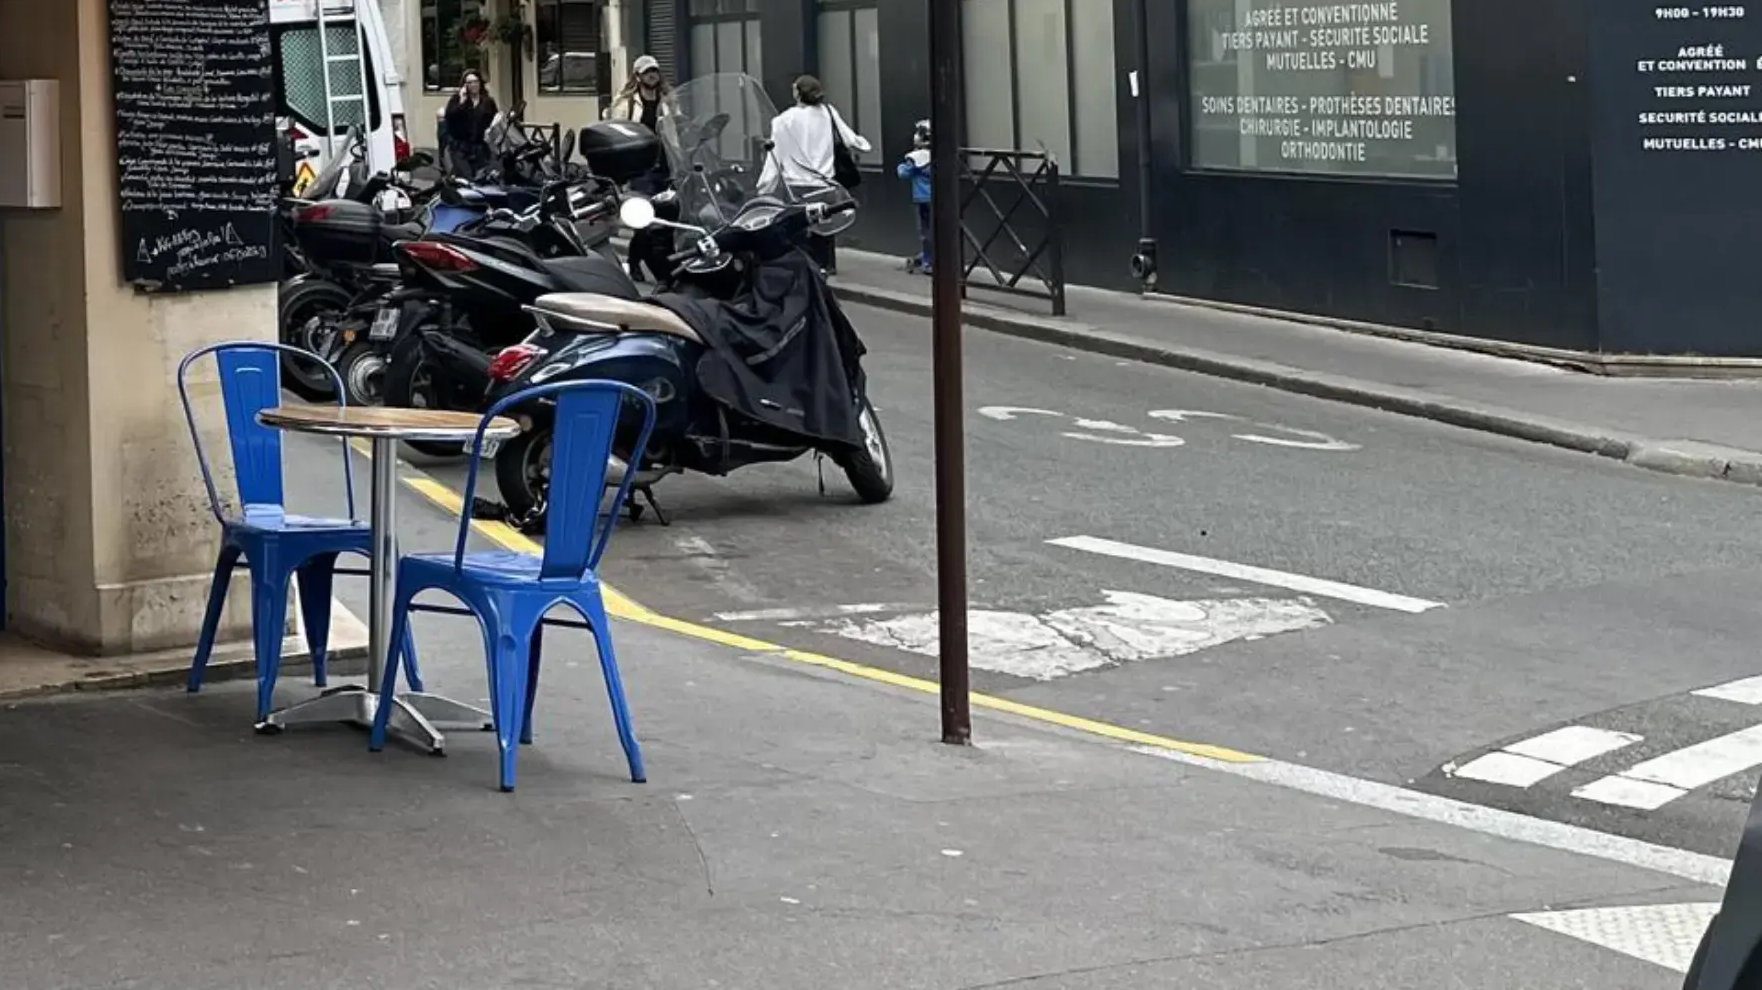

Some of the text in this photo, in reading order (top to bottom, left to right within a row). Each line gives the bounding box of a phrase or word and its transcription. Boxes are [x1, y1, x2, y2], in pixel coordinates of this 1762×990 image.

[1245, 2, 1282, 28] AGRÉÉ
[1285, 8, 1298, 25] ET
[1655, 8, 1689, 19] 9H00
[1702, 6, 1745, 18] 19H30
[1222, 33, 1253, 50] TIERS
[1256, 30, 1298, 48] PAYANT
[1373, 25, 1429, 46] SOCIALE
[1678, 43, 1724, 58] AGRÉÉ
[1266, 52, 1336, 71] MUTUELLES
[1347, 51, 1375, 69] CMU
[1637, 60, 1655, 72] ET
[1654, 85, 1751, 97] TIERS PAYANT
[1202, 96, 1234, 114] SOINS
[1237, 96, 1299, 114] DENTAIRES
[1309, 91, 1381, 115] PROTHÈSES
[1638, 109, 1706, 123] SECURITÉ
[1240, 118, 1301, 137] CHIRURGIE
[1311, 119, 1413, 139] IMPLANTOLOGIE
[1281, 141, 1366, 161] ORTHODONTIE
[1643, 138, 1726, 150] MUTUELLES
